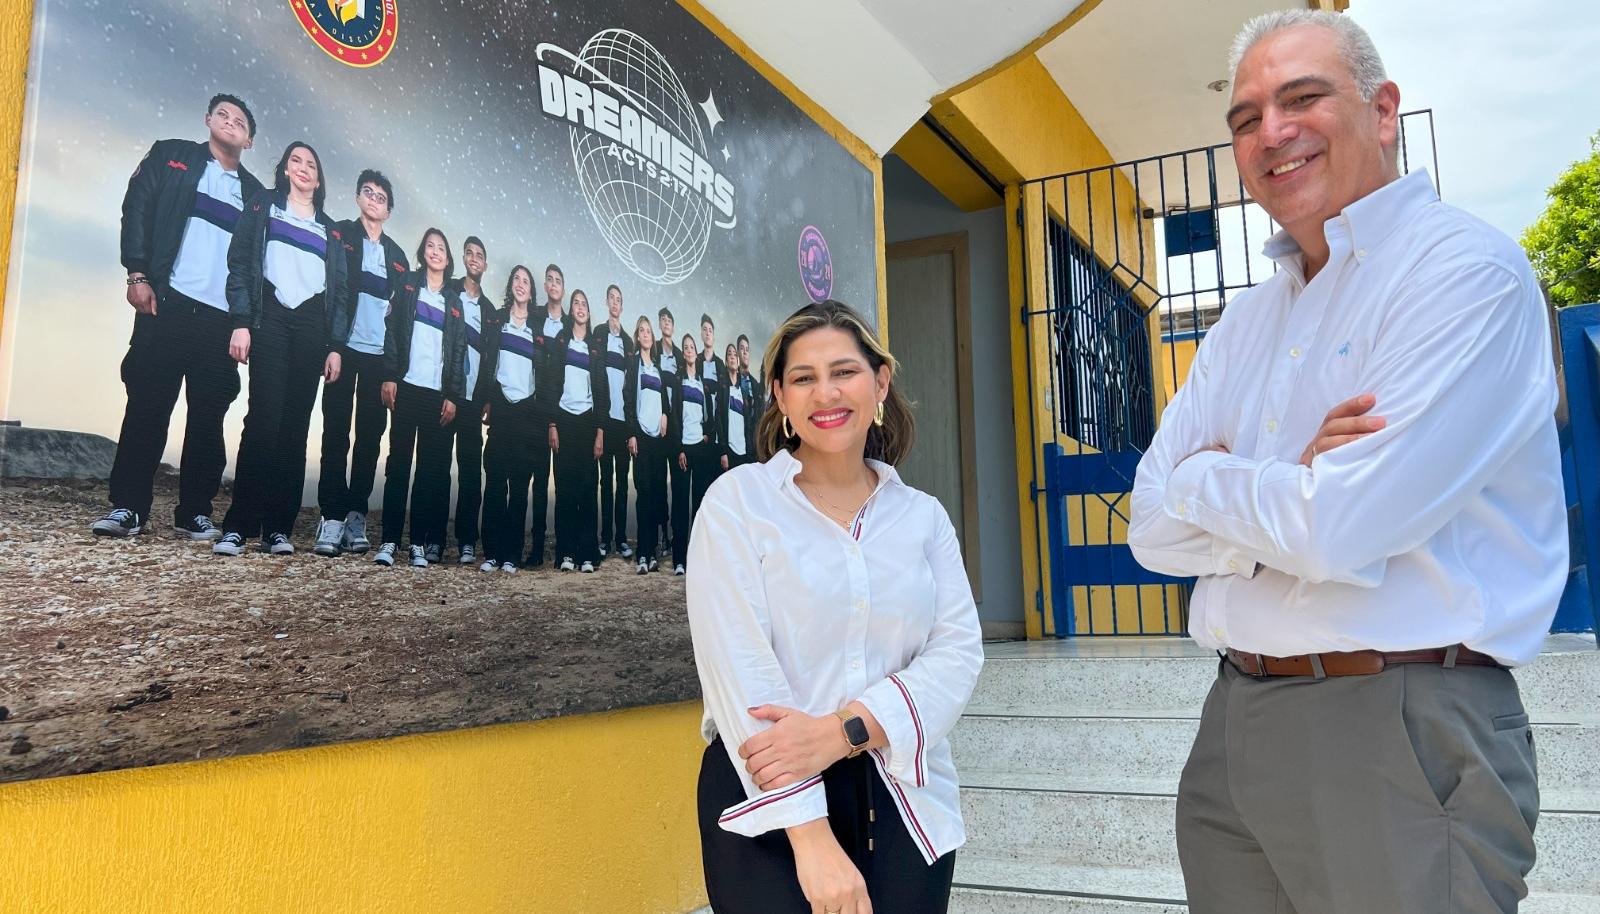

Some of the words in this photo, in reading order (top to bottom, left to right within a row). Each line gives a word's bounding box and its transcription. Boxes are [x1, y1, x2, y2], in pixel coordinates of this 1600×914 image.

[538, 65, 735, 217] DREAMERS
[607, 142, 658, 179] ACTS
[659, 169, 690, 198] 2:17
